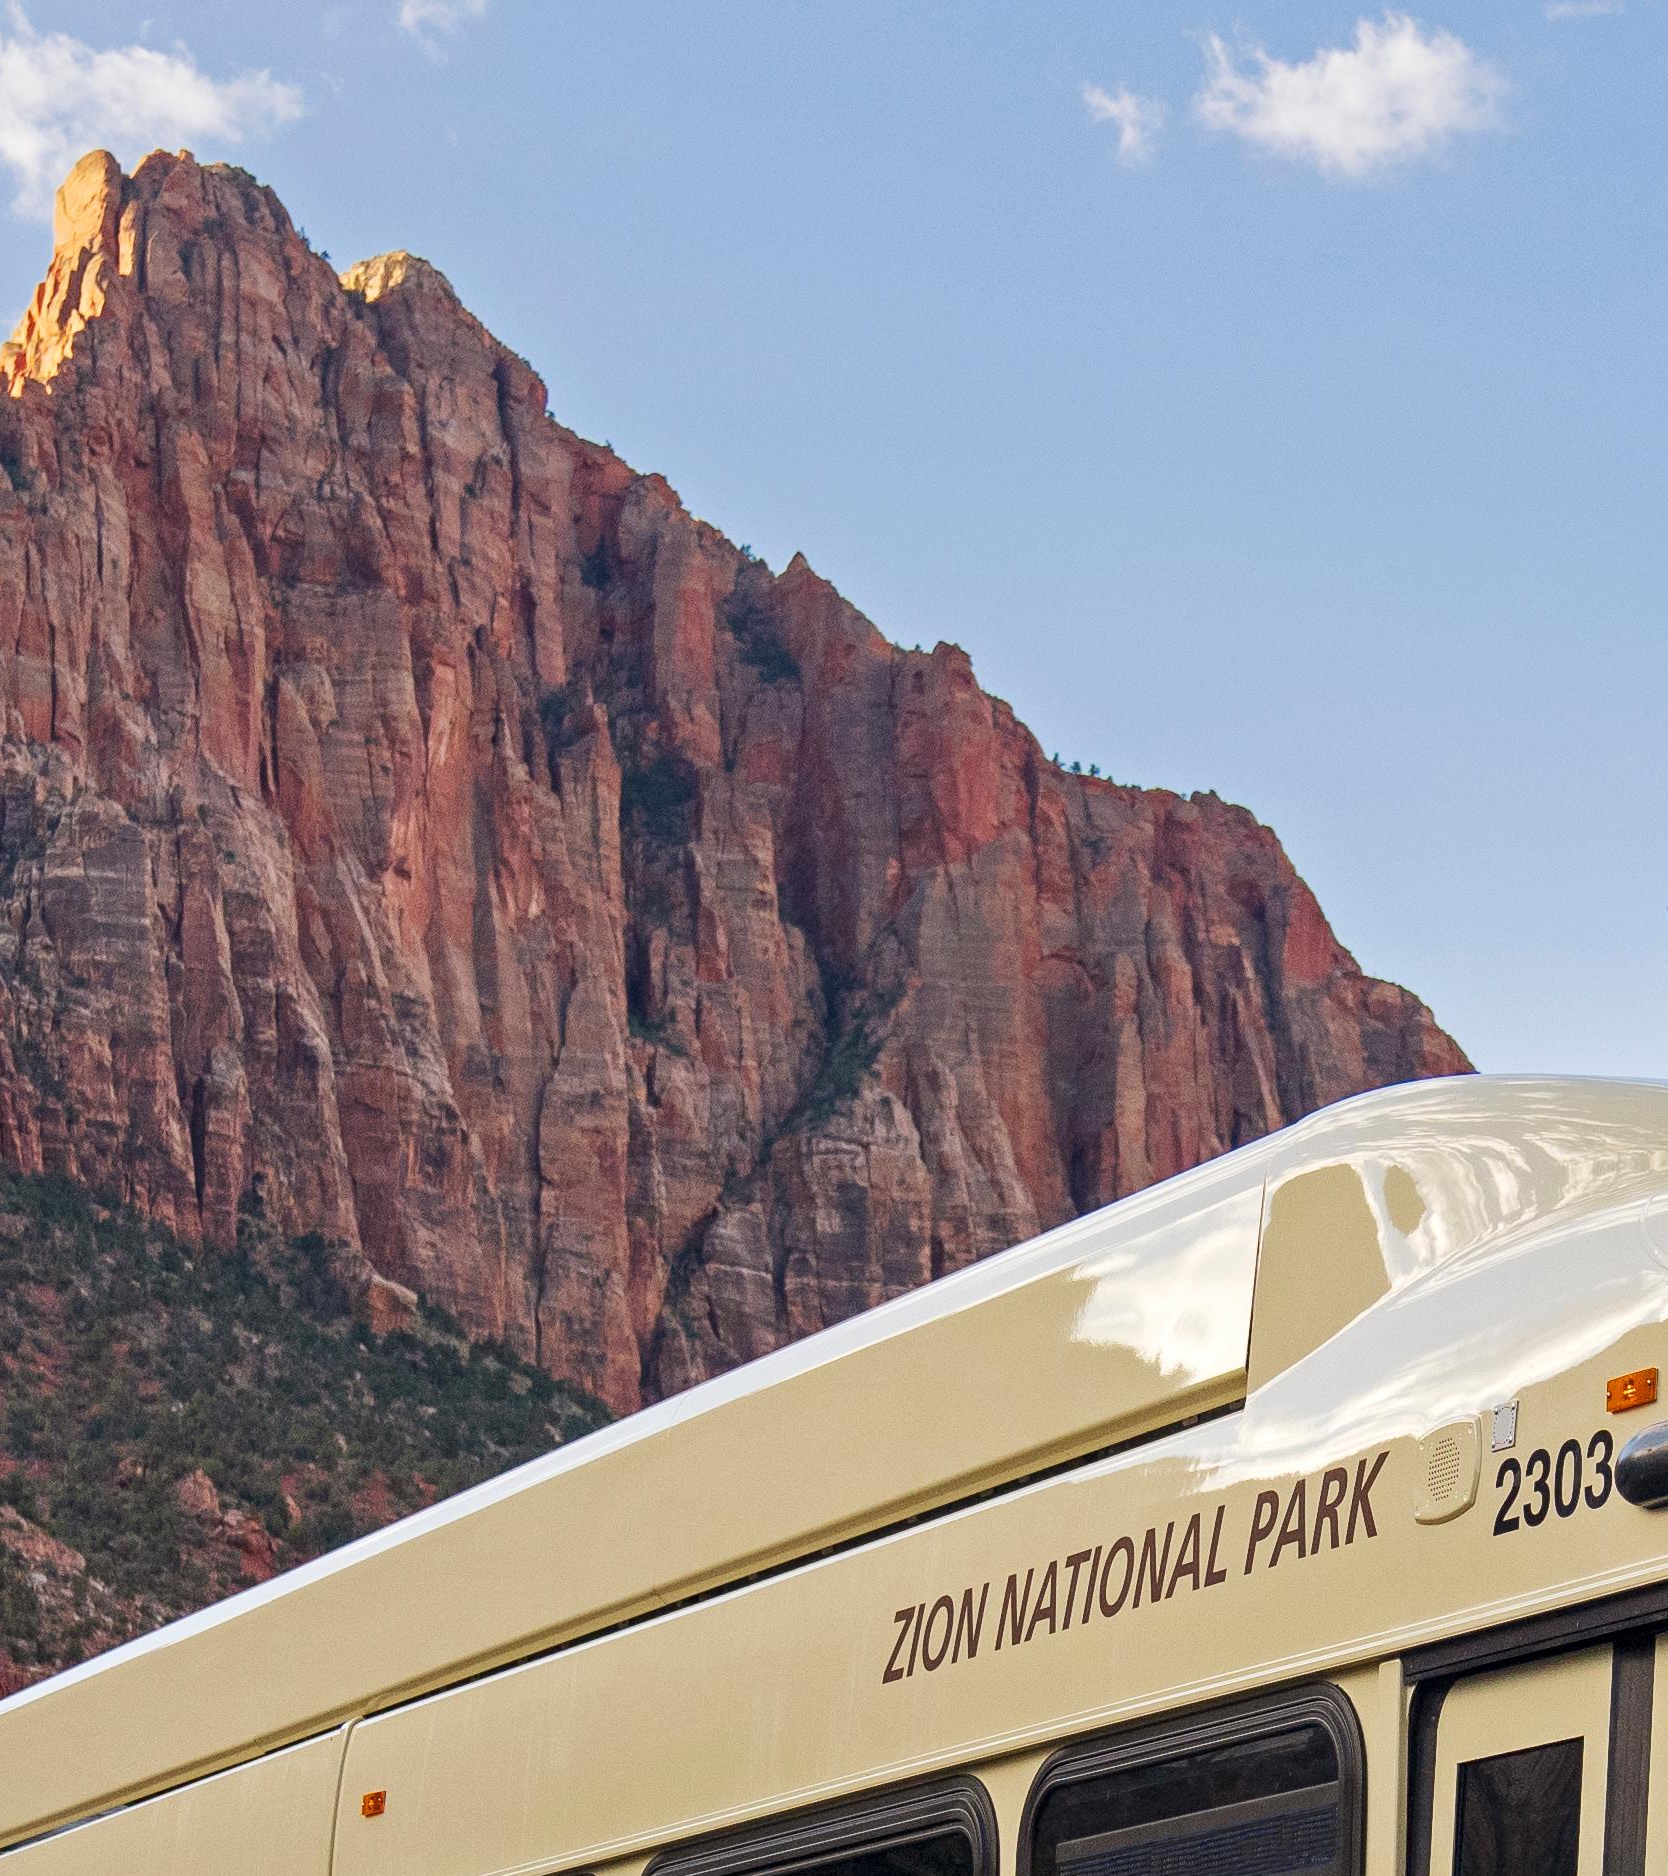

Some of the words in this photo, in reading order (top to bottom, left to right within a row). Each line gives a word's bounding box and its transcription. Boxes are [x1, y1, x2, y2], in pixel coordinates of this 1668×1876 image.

[882, 1583, 989, 1685] ZION
[995, 1505, 1227, 1651] NATIONAL
[1244, 1451, 1390, 1575] PARK
[1493, 1430, 1613, 1536] 2303
